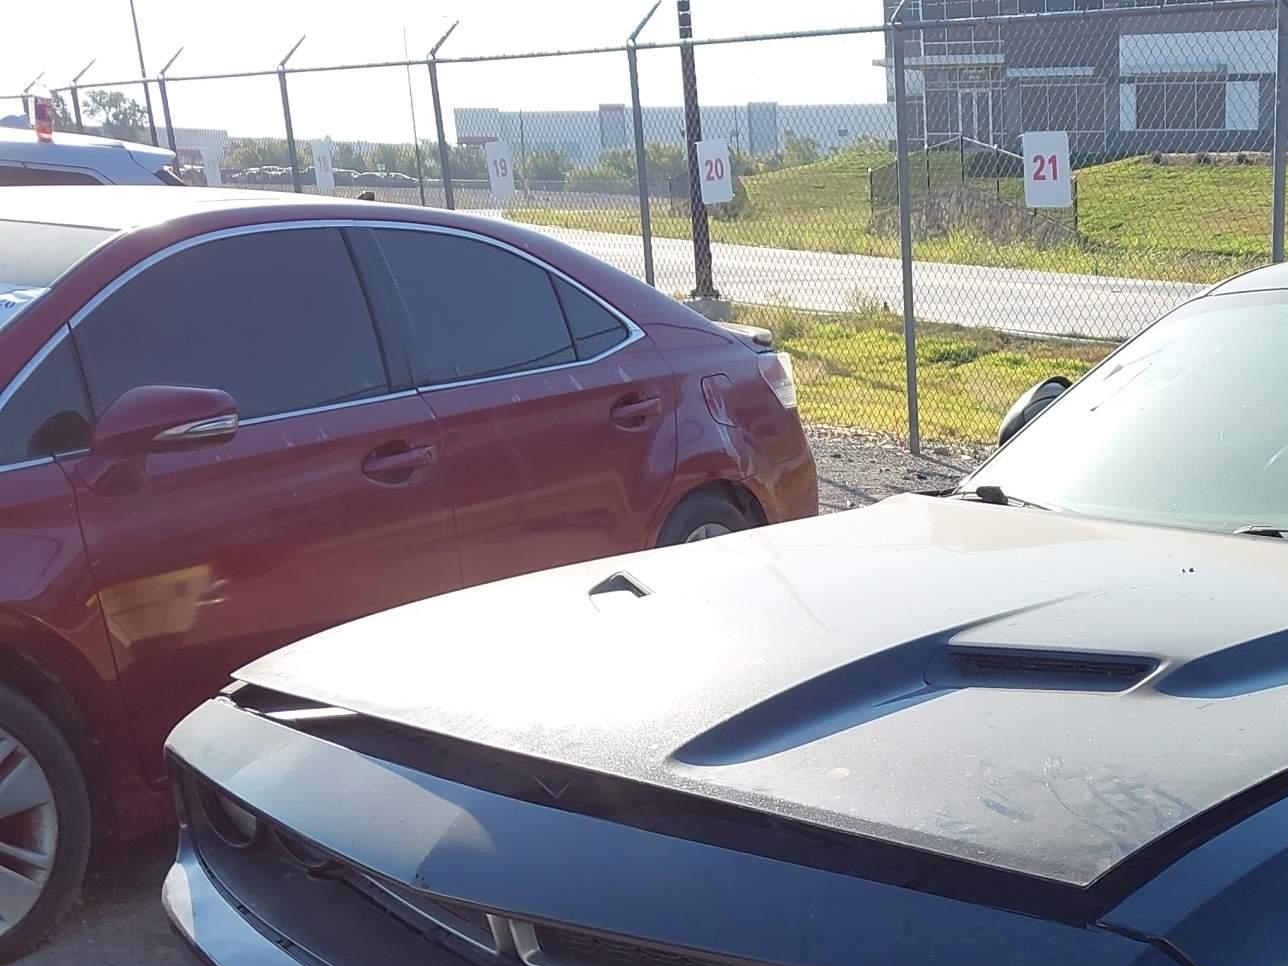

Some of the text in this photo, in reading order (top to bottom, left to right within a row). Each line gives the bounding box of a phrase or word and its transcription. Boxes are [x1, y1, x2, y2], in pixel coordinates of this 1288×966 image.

[494, 159, 508, 177] 19
[705, 158, 724, 181] 20
[1032, 153, 1058, 180] 21
